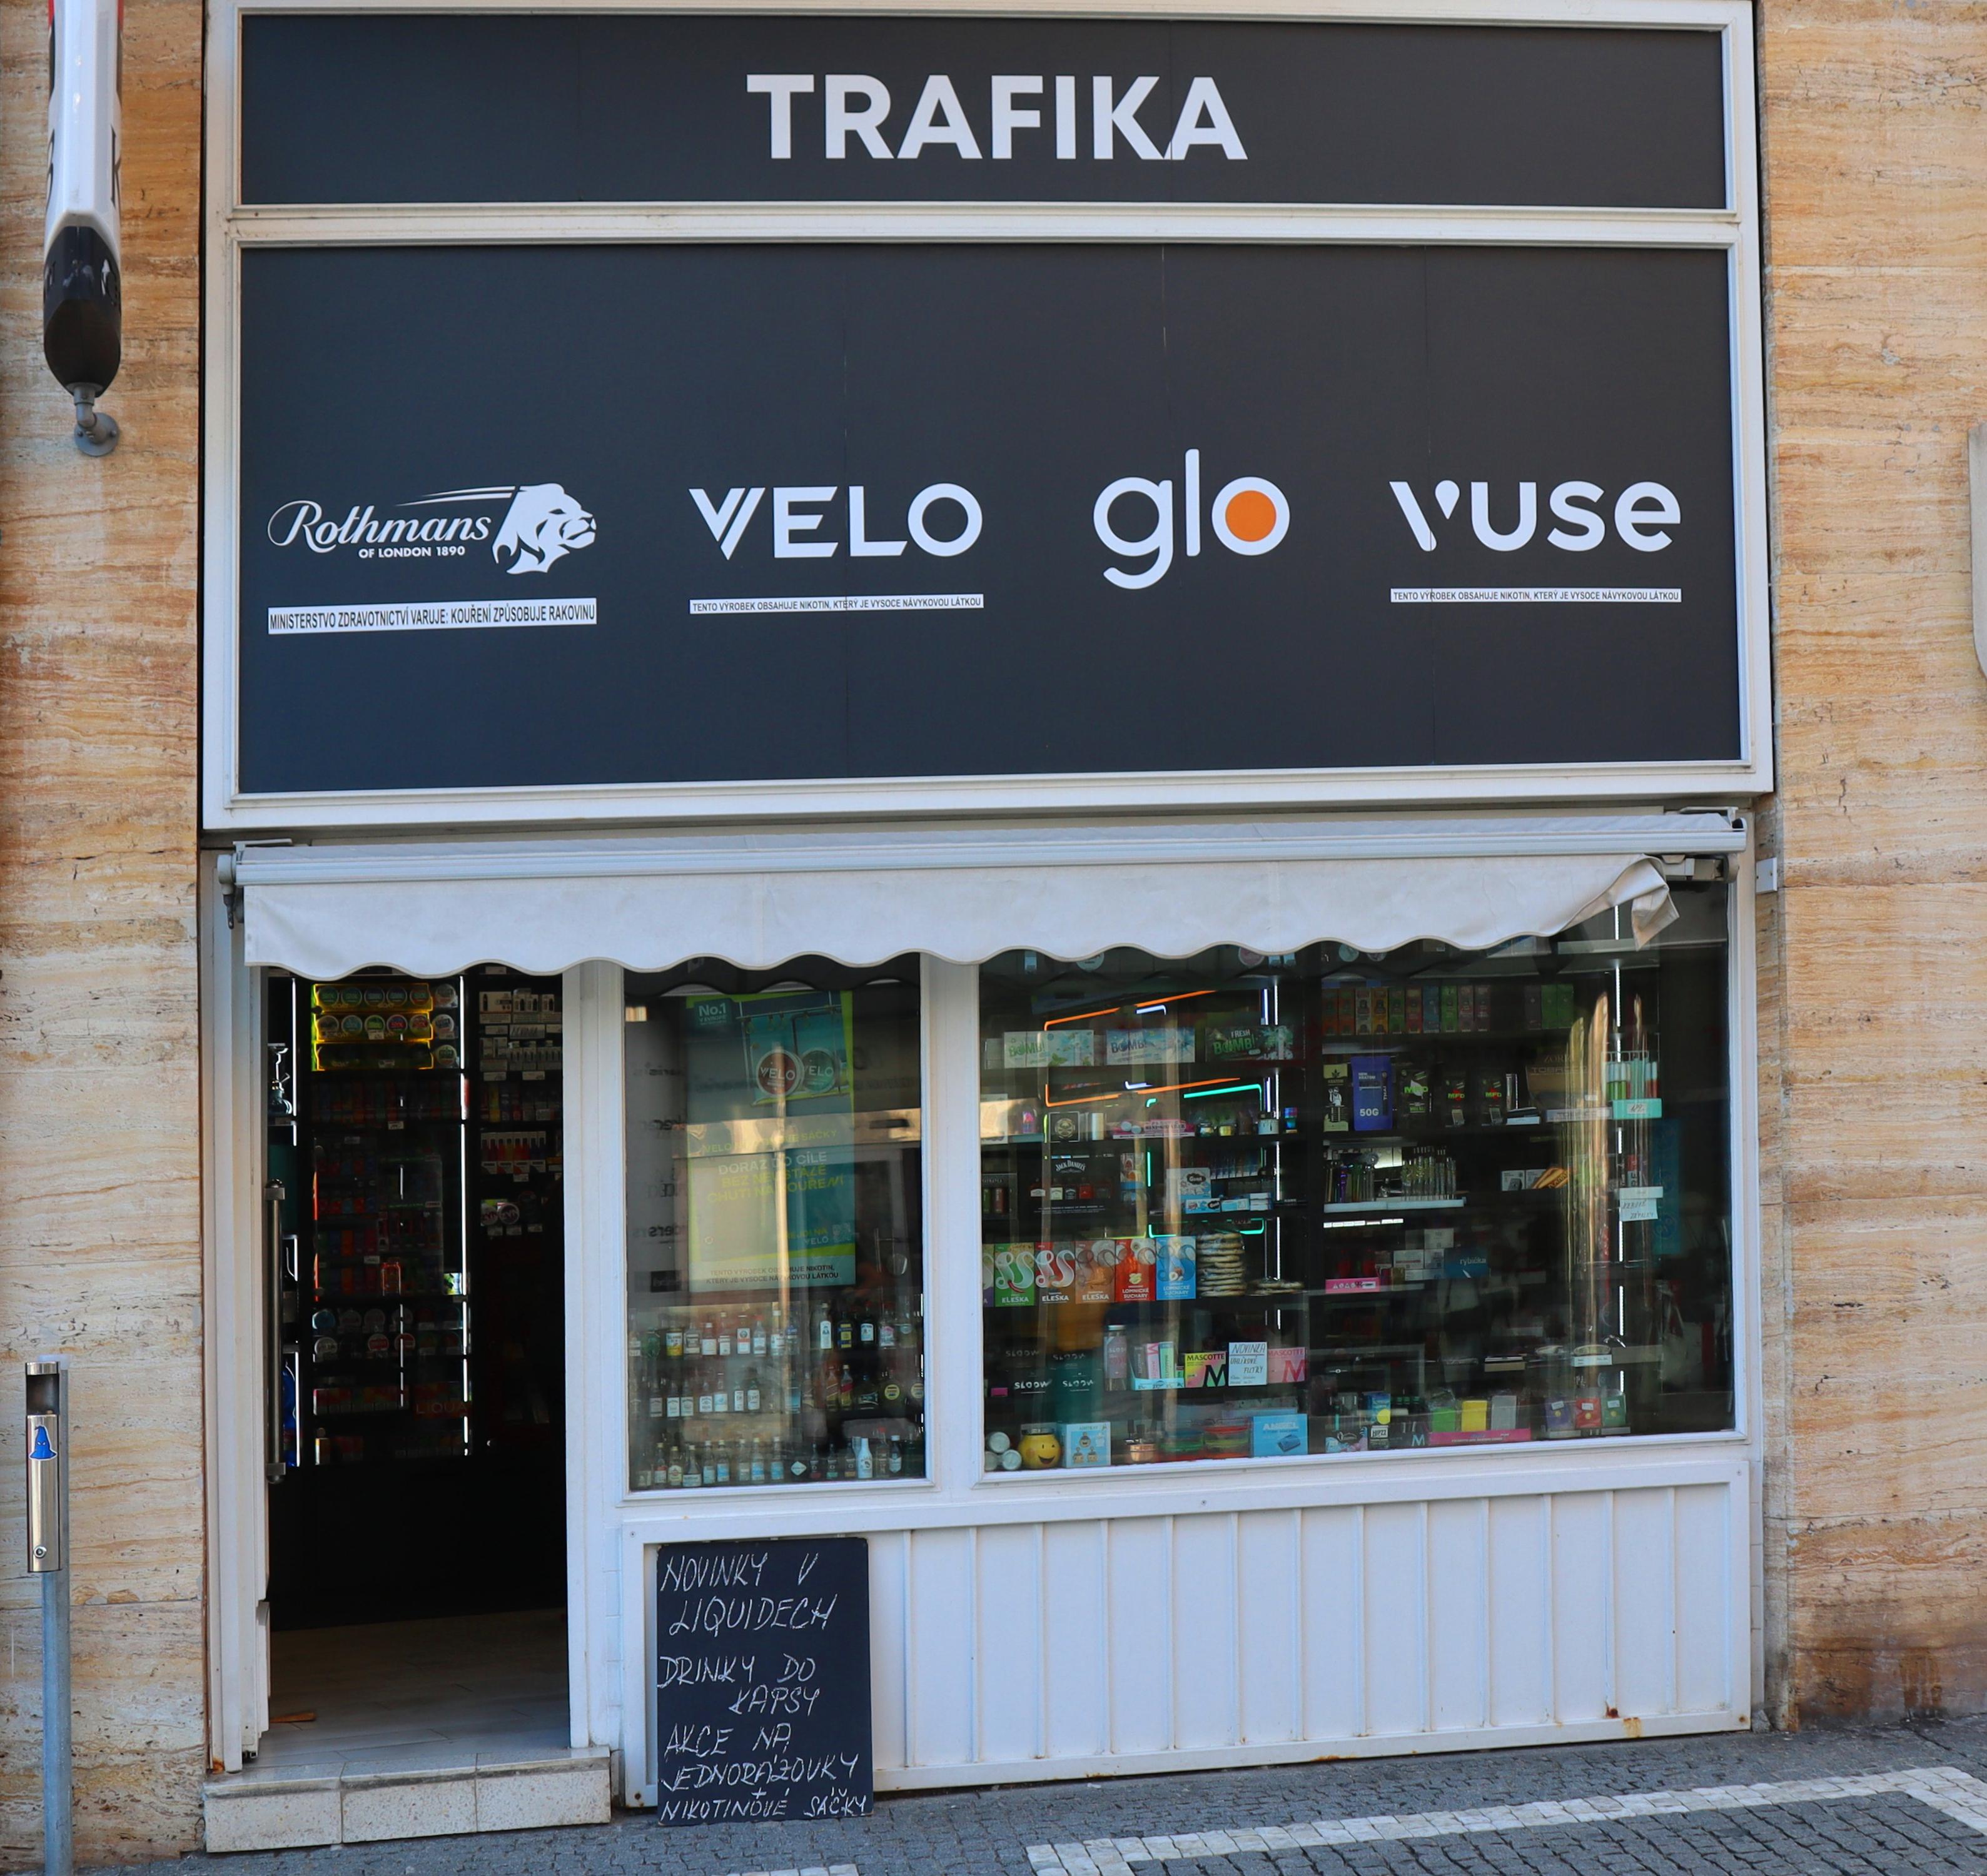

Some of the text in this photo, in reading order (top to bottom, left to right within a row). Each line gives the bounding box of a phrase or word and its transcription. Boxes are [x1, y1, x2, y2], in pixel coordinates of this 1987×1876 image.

[747, 74, 1248, 160] TRAFIKA
[268, 500, 492, 553] Rothmans
[689, 483, 983, 560] VELO
[1093, 448, 1291, 590] glo
[358, 545, 465, 558] OF LONDON 1890
[692, 595, 981, 612] TENTO VÝROBEK OBSAHUJE NIKOTIN, KTERÝ JE VYSOCE NÁVYKOVOU LÁTKOU
[1394, 589, 1679, 602] TENTO VÝROBEK OBSAHUJE NIKOTIN, KTERÝ JE VYSOCE NÁVYKOVOU LÁTKOU
[270, 602, 595, 630] MINISTERSTVO ZDRAVOTNICTVÍ VARUJE: KOUŘENÍ ZPŮSOBUJE RAKOVINU
[698, 1002, 726, 1017] No.1
[1230, 1028, 1251, 1039] FRESH
[760, 1066, 796, 1081] VELO
[1359, 1107, 1380, 1117] 50G
[719, 1159, 768, 1176] DORAZ
[796, 1151, 827, 1166] CÍLE
[1002, 1295, 1029, 1303] ELEŠKA
[1186, 1353, 1225, 1361] MASCOTTE
[660, 1552, 819, 1591] NOVINKY V
[669, 1593, 838, 1637] LIQUIDECH
[656, 1653, 816, 1688] DRINKY DO
[728, 1684, 820, 1716] KAPSY
[664, 1722, 792, 1762] AKCE NA
[803, 1786, 867, 1818] SÁČKY
